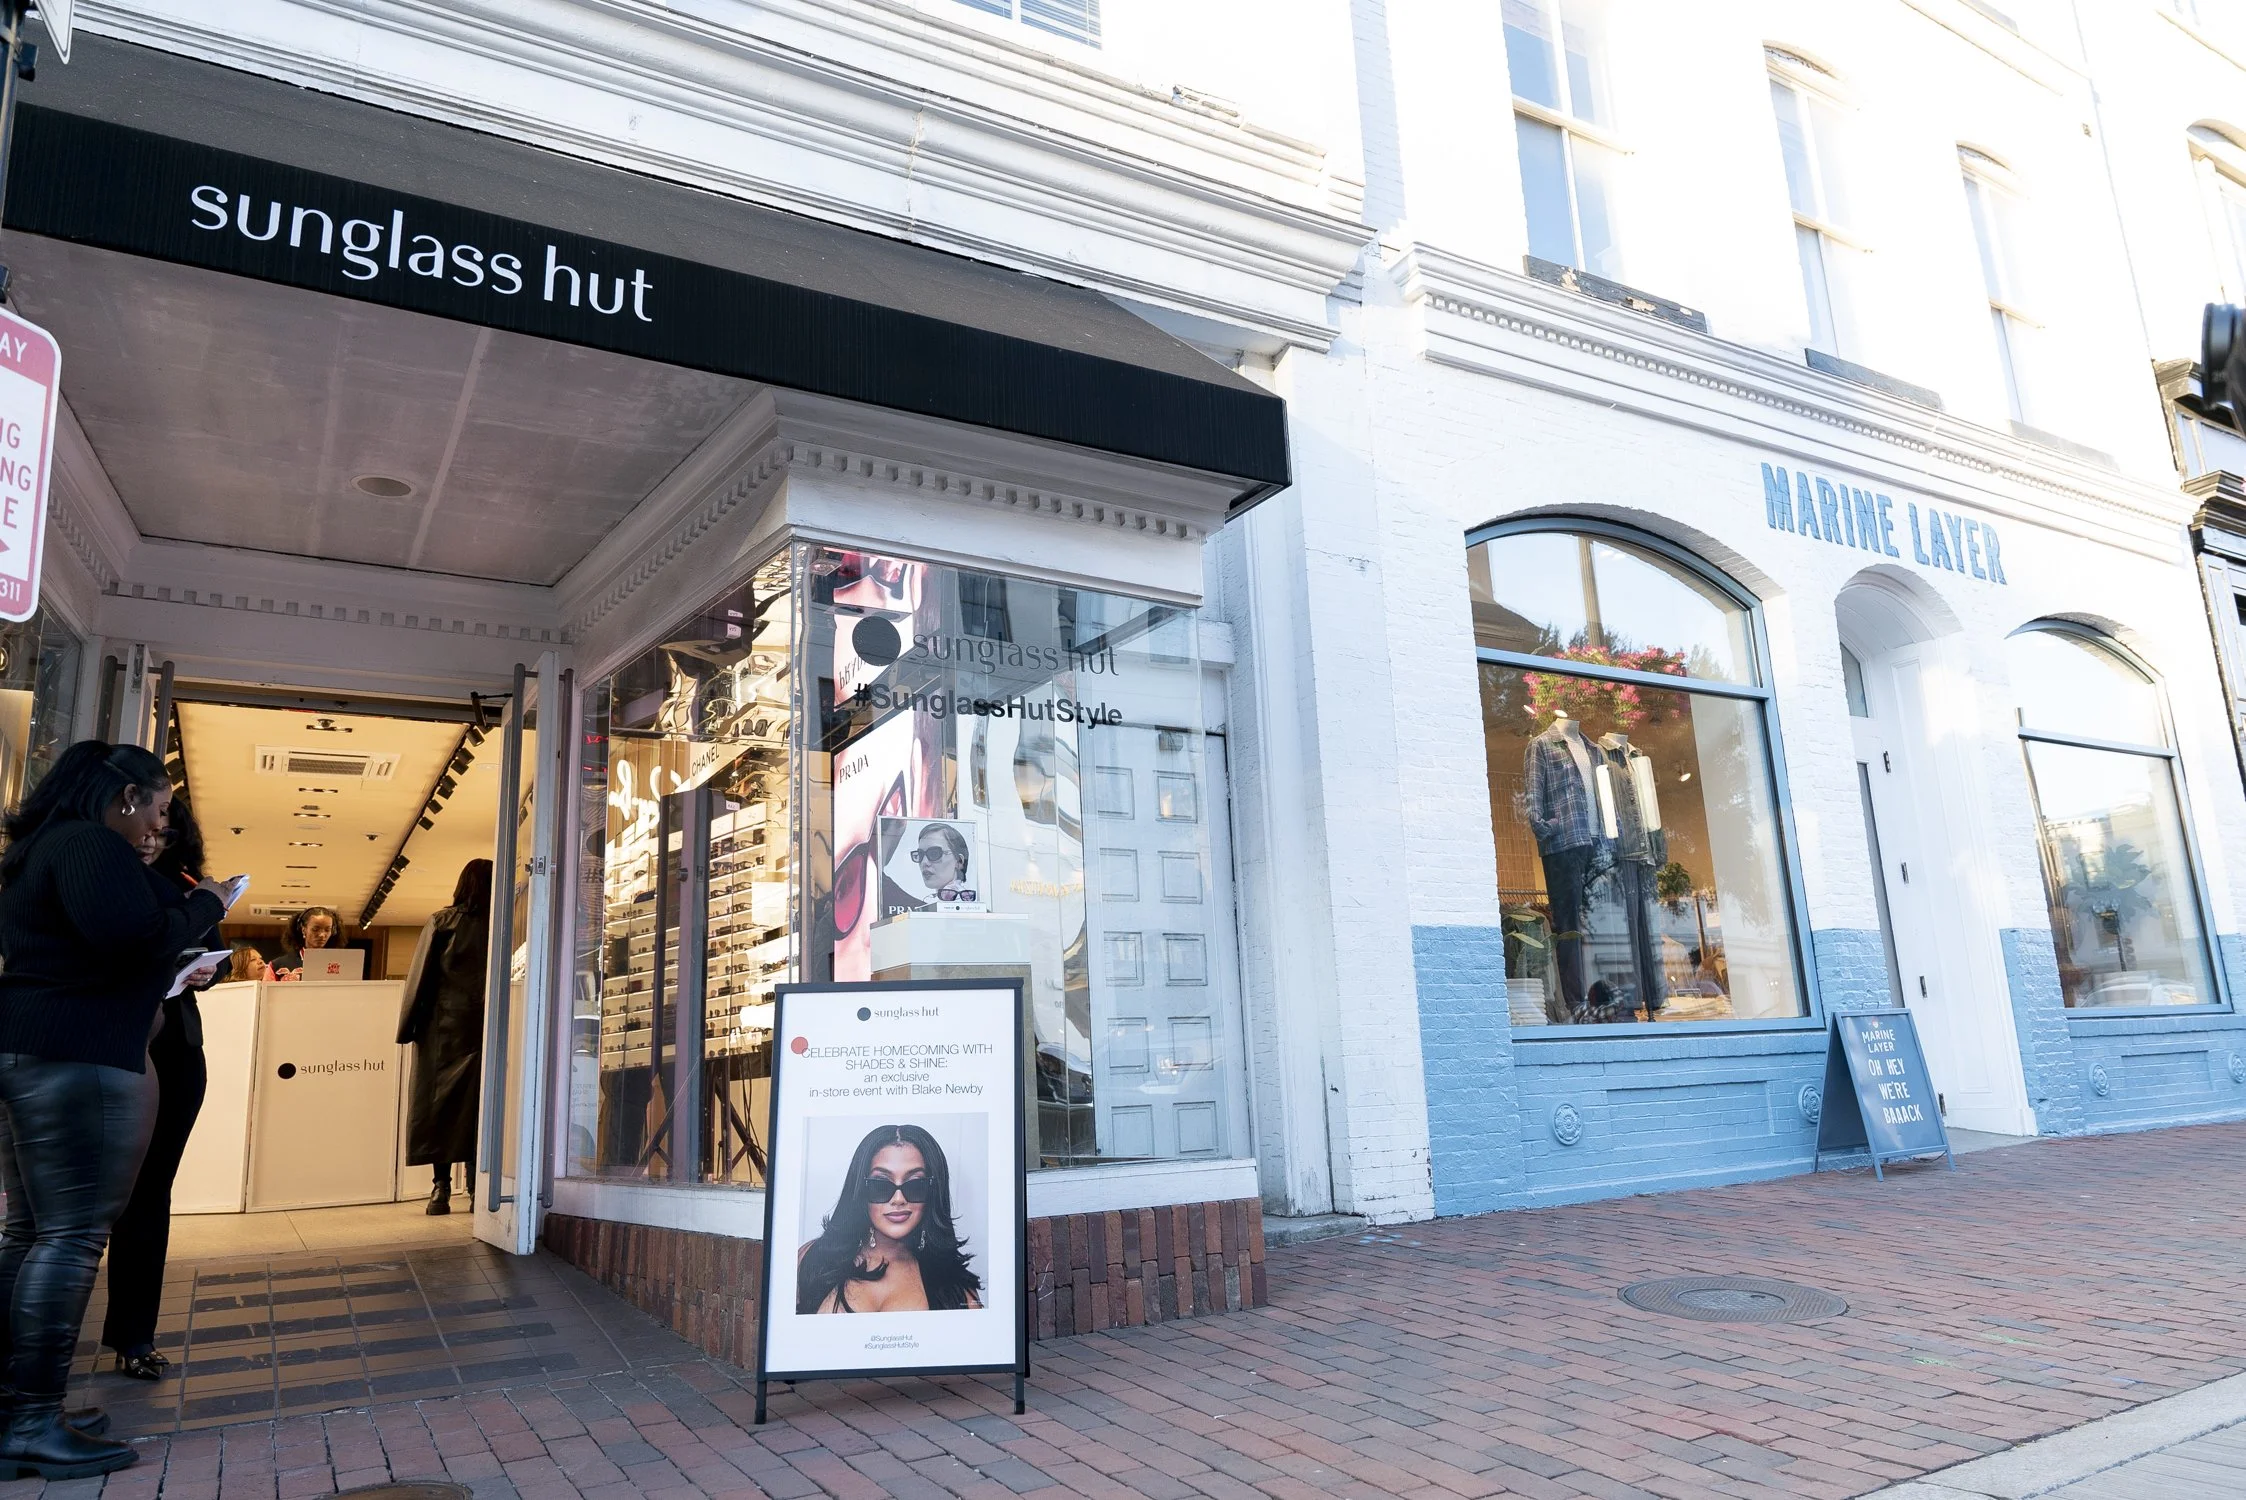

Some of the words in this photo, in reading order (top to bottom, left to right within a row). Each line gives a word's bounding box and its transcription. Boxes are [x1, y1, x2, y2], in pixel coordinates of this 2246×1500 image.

[191, 185, 522, 295] sunglass
[543, 245, 653, 322] hut
[1761, 462, 1900, 558] MARINE
[1908, 502, 2008, 585] LAYER
[912, 632, 1059, 675] sunglass
[1068, 638, 1120, 676] hut
[853, 683, 1123, 729] #SunglassHutStyle
[691, 744, 720, 777] CHANEL
[839, 754, 869, 783] PRADA
[874, 1007, 920, 1020] sunglass
[922, 1006, 940, 1017] hut
[1862, 1029, 1895, 1043] MARINE
[801, 1046, 870, 1059] CELEBRATE
[873, 1044, 960, 1057] HOMECOMING
[962, 1043, 993, 1055] WITH
[1868, 1042, 1894, 1053] LAYER
[300, 1060, 361, 1076] sunglass
[363, 1058, 385, 1072] hut
[845, 1058, 895, 1071] SHADES
[897, 1058, 906, 1069] &
[909, 1057, 948, 1069] SHINE:
[1868, 1058, 1883, 1076] OH
[1886, 1058, 1906, 1076] HEY
[863, 1073, 878, 1083] an
[881, 1070, 930, 1083] exclusive
[809, 1087, 850, 1098] in-store
[853, 1085, 882, 1097] event
[885, 1084, 908, 1096] with
[911, 1083, 942, 1095] Blake
[945, 1083, 984, 1096] Newby
[1878, 1081, 1911, 1100] WE'RE
[1882, 1104, 1924, 1125] BAAACK
